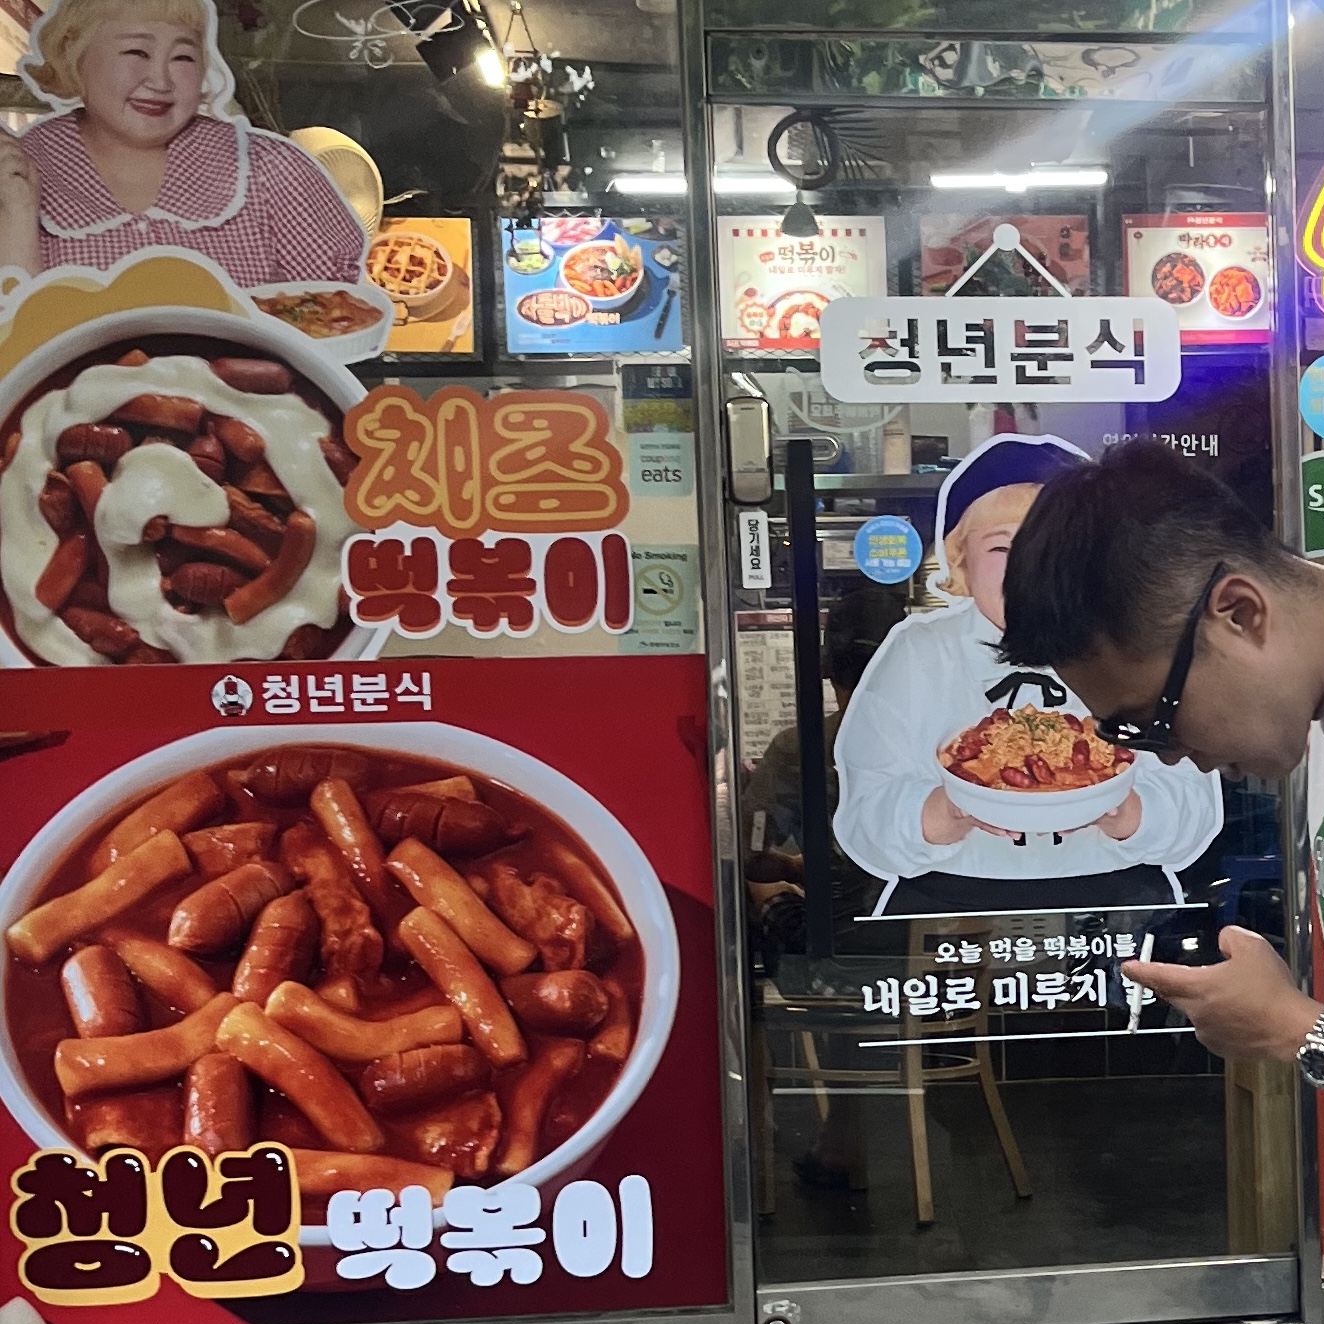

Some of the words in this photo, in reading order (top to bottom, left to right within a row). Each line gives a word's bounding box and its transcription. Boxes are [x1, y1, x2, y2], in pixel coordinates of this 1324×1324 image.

[777, 241, 836, 265] 떡볶이
[857, 317, 1147, 387] 청년분식
[357, 396, 619, 531] 치즈
[641, 466, 683, 482] eats
[644, 551, 688, 562] Smoking
[747, 518, 762, 570] 당기세요
[347, 535, 630, 633] 떡볶이
[262, 672, 433, 714] 청년분식
[934, 936, 982, 964] 오늘
[988, 935, 1037, 962] 먹을
[1043, 933, 1137, 960] 떡볶이를
[862, 976, 982, 1017] 내일로
[992, 968, 1107, 1012] 미루지
[11, 1141, 304, 1305] 청년
[326, 1174, 654, 1289] 떡볶이
